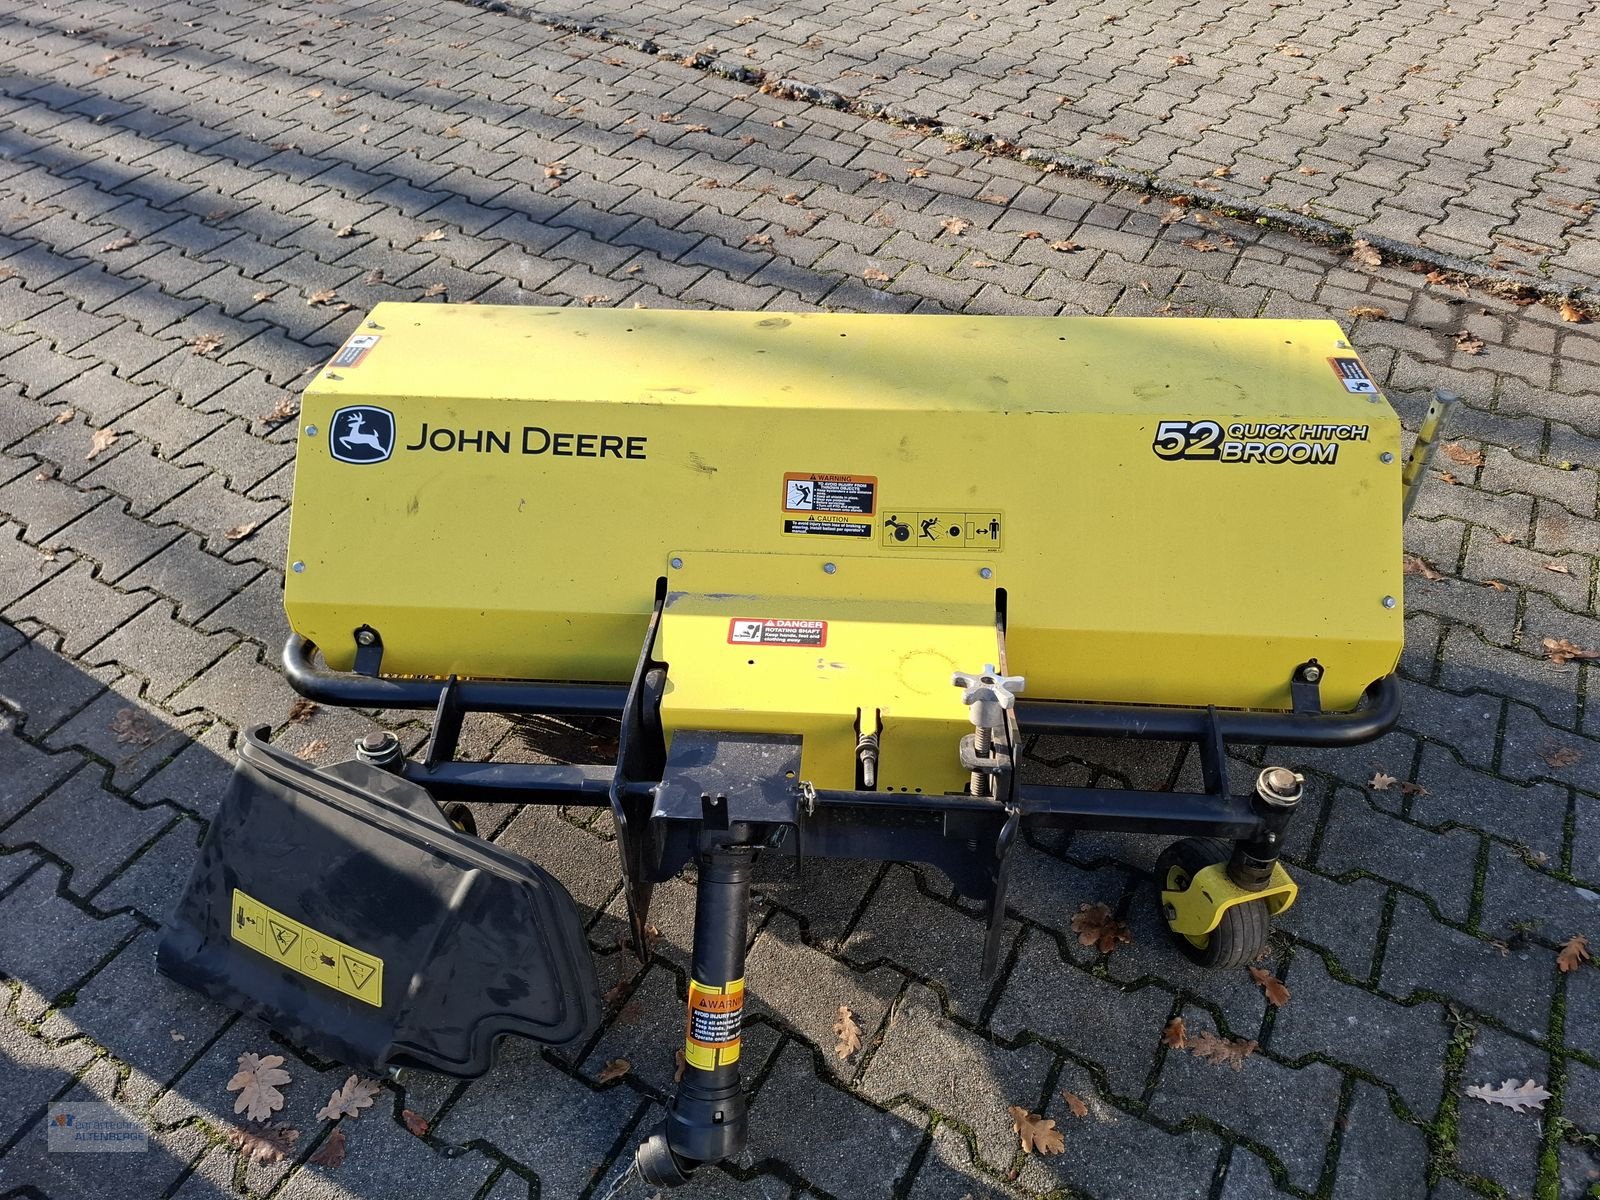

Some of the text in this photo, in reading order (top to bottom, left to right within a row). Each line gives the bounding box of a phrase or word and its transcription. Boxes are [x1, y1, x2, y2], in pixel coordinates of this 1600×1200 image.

[1227, 423, 1369, 441] QUICK HITCH
[406, 423, 648, 460] JOHN DEERE
[1153, 420, 1224, 461] 52
[1220, 441, 1339, 464] BROOM
[776, 620, 823, 628] DANGER
[708, 997, 743, 1008] WARN
[694, 1010, 709, 1018] AVOID
[695, 1017, 707, 1025] Keep
[695, 1022, 707, 1030] Keep
